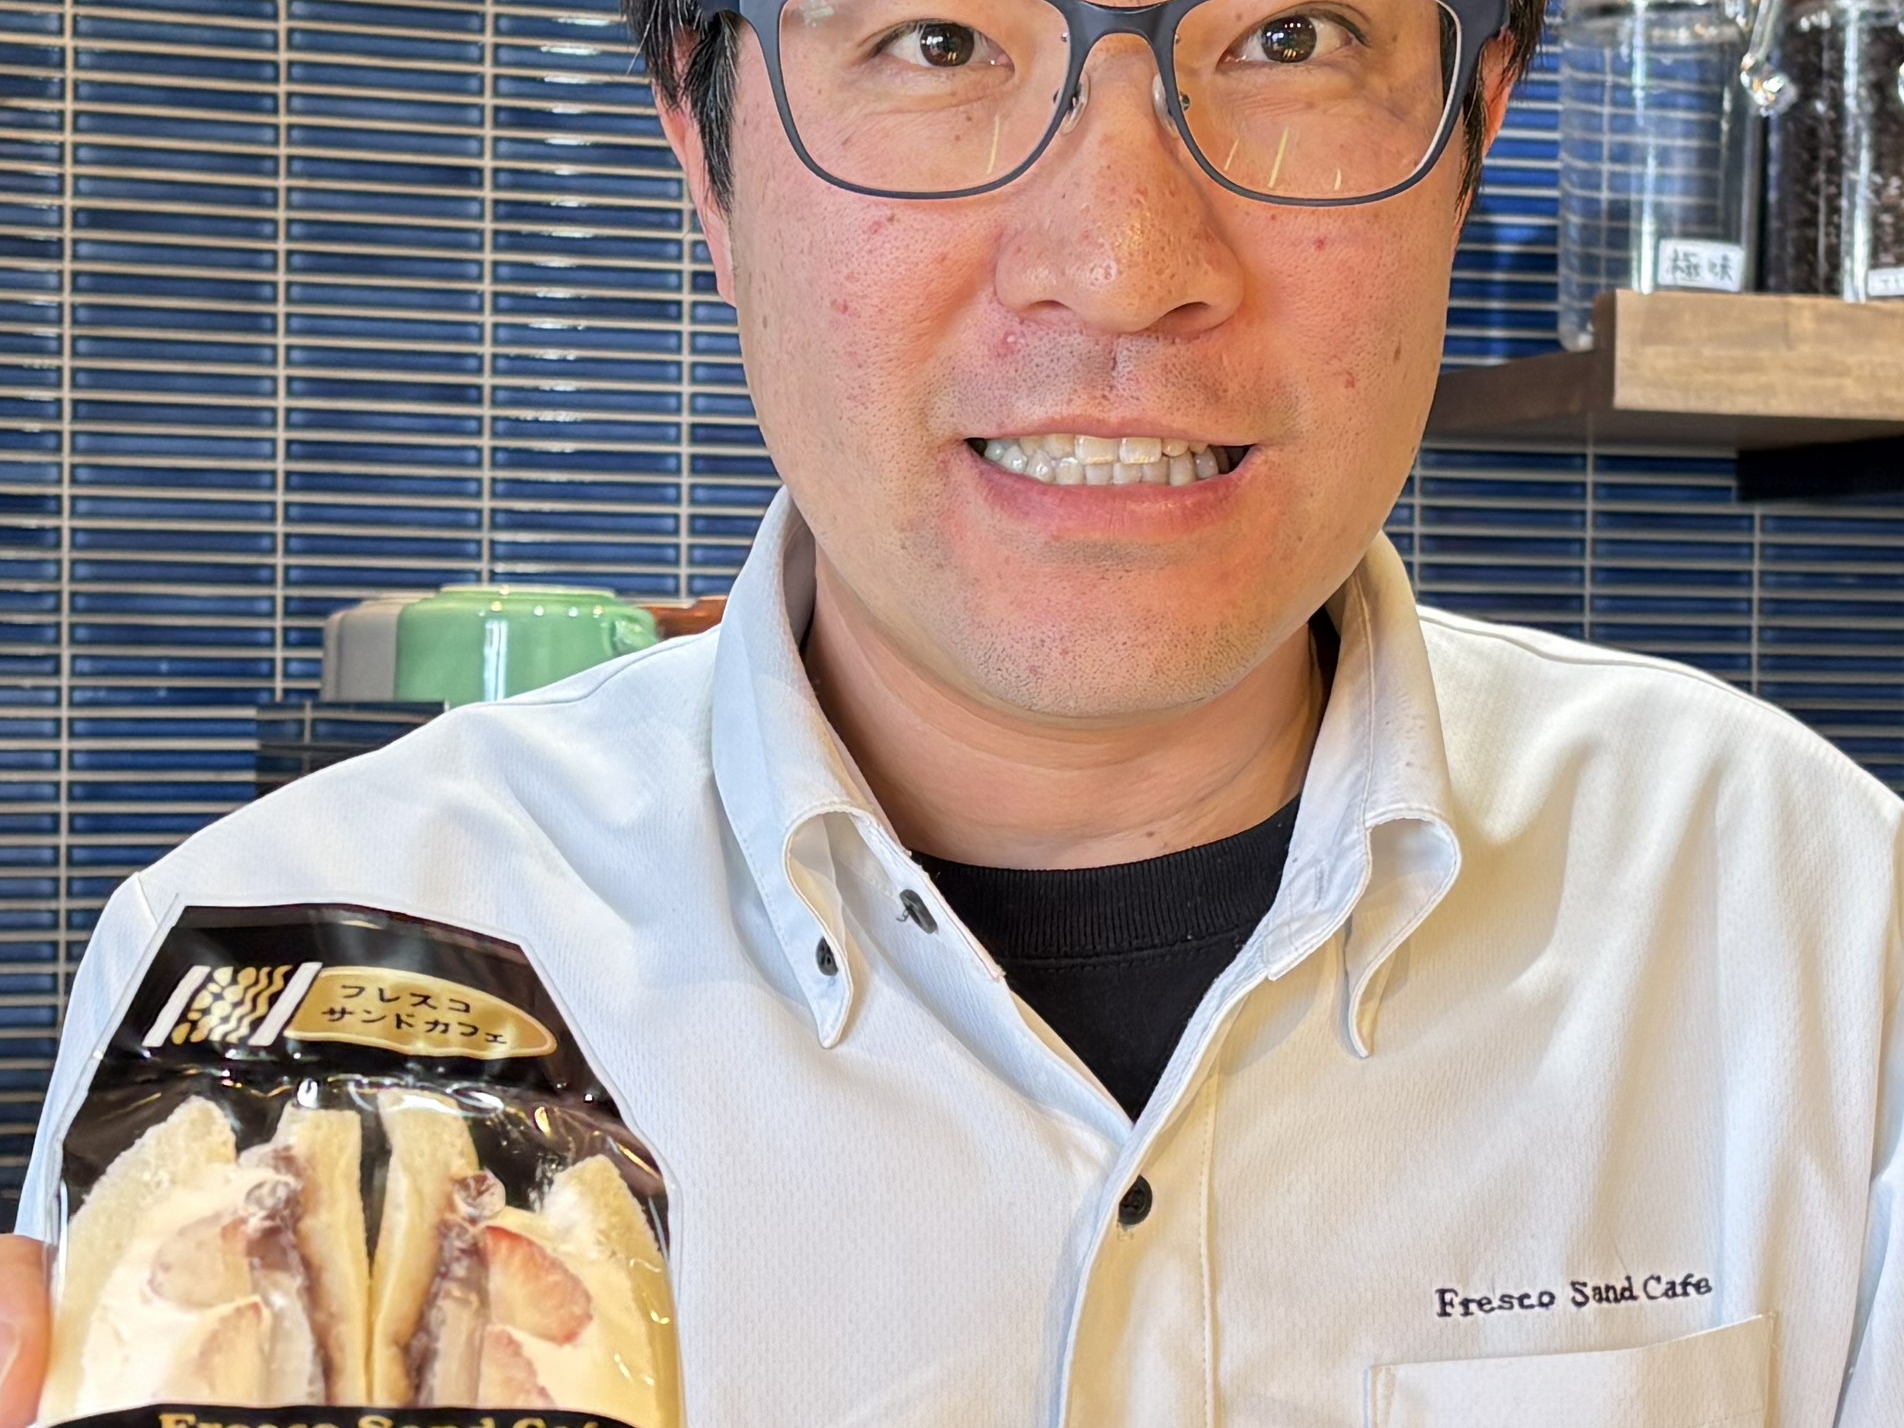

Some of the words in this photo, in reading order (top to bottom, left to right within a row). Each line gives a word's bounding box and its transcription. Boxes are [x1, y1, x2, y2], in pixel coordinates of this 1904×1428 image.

[340, 984, 471, 1014] フレスコ
[322, 1006, 508, 1045] サンドカフェ
[1435, 1287, 1556, 1318] Fresco
[1569, 1275, 1638, 1308] Sand
[1642, 1272, 1713, 1300] Cafe
